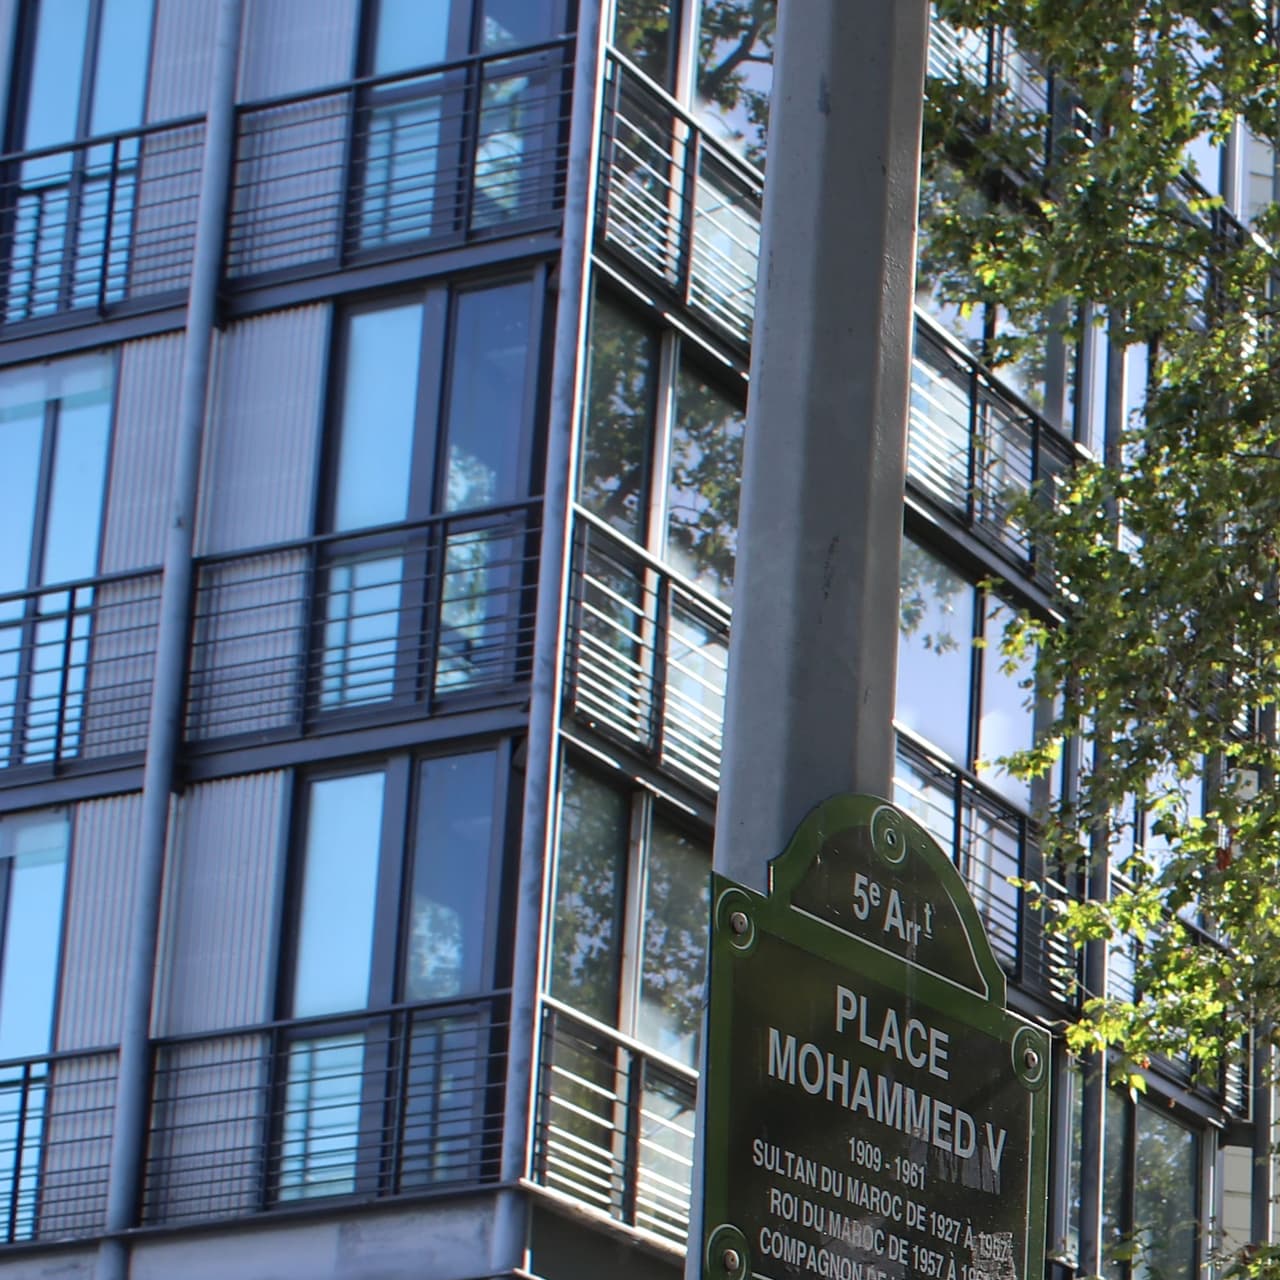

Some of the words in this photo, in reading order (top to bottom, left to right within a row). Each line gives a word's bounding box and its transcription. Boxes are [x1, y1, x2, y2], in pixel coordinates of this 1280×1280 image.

[835, 984, 949, 1080] PLACE
[768, 1026, 976, 1159] MOHAMMED
[985, 1122, 1008, 1174] V
[752, 1138, 817, 1188] SULTAN
[821, 1165, 843, 1198] DU
[847, 1176, 903, 1221] MAROC
[906, 1200, 927, 1232] DE
[929, 1210, 962, 1245] 1927
[964, 1217, 974, 1249] À
[849, 1136, 882, 1172] 1909
[895, 1155, 926, 1191] 1961
[770, 1187, 799, 1223] ROI
[802, 1199, 825, 1232] DU
[828, 1210, 885, 1256] MAROC
[888, 1233, 909, 1266] DE
[912, 1244, 944, 1279] 1957
